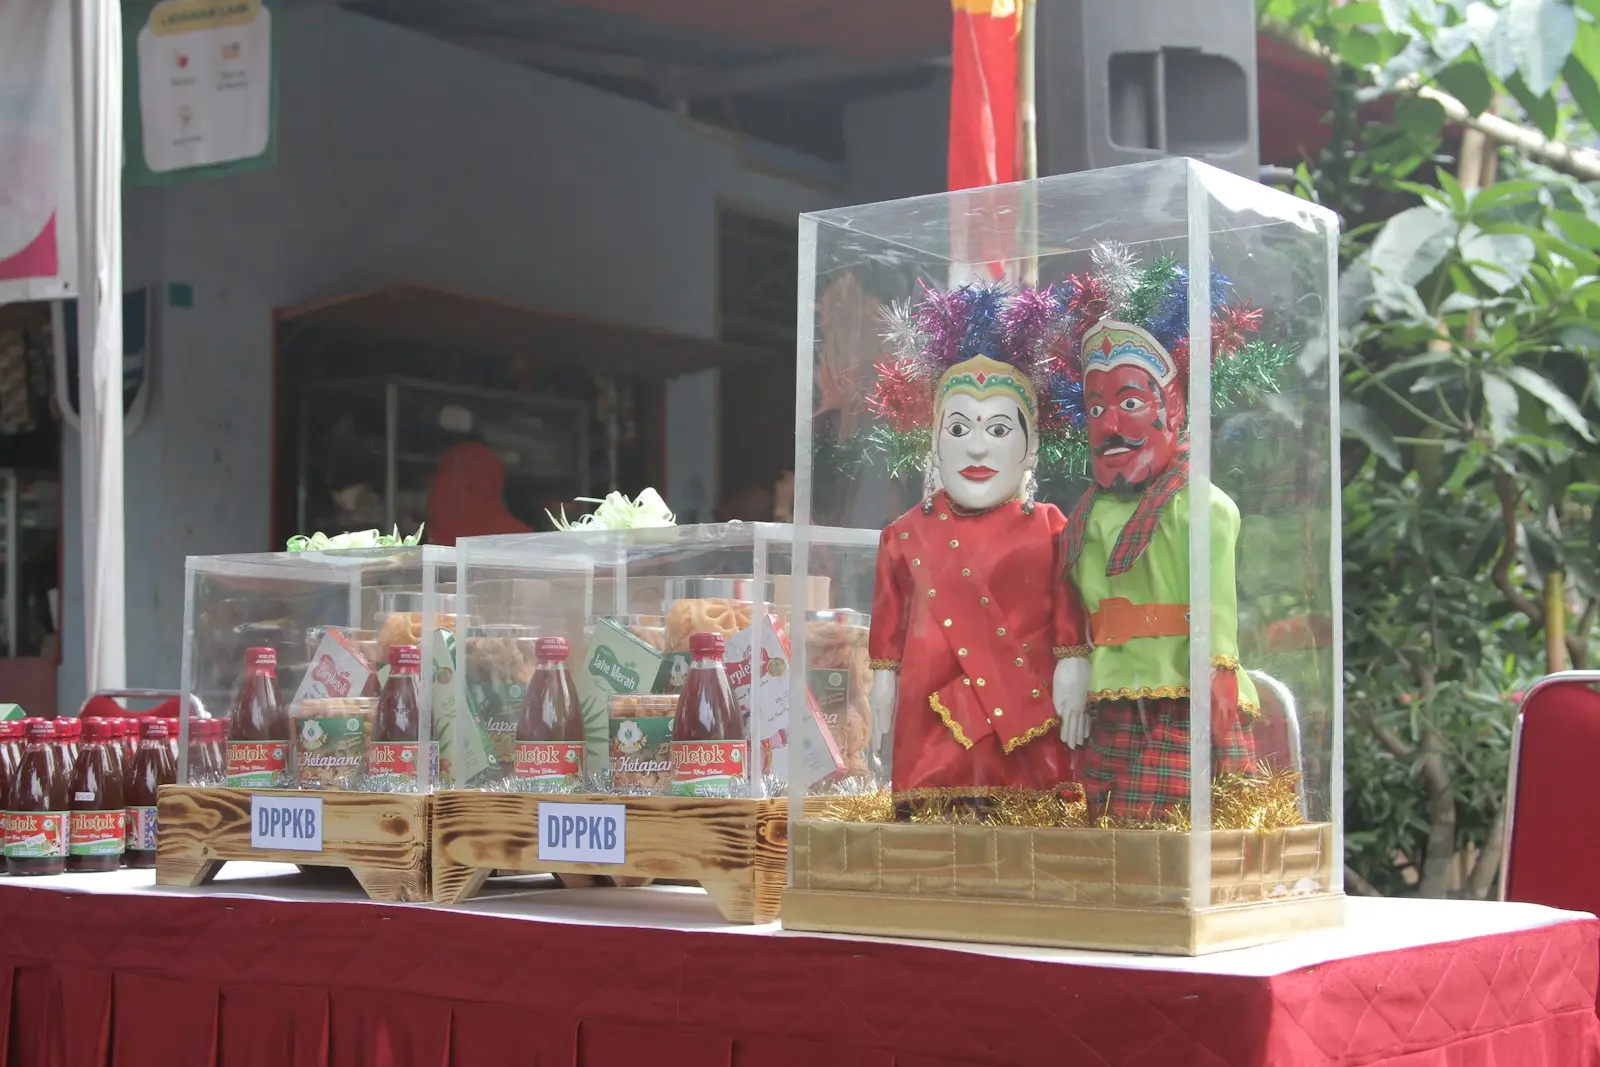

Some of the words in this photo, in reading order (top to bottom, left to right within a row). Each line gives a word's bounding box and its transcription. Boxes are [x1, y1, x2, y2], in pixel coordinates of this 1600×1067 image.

[593, 653, 611, 674] Jahe
[610, 664, 636, 690] Merah
[258, 806, 316, 839] DPPKB
[547, 814, 617, 850] DPPKB
